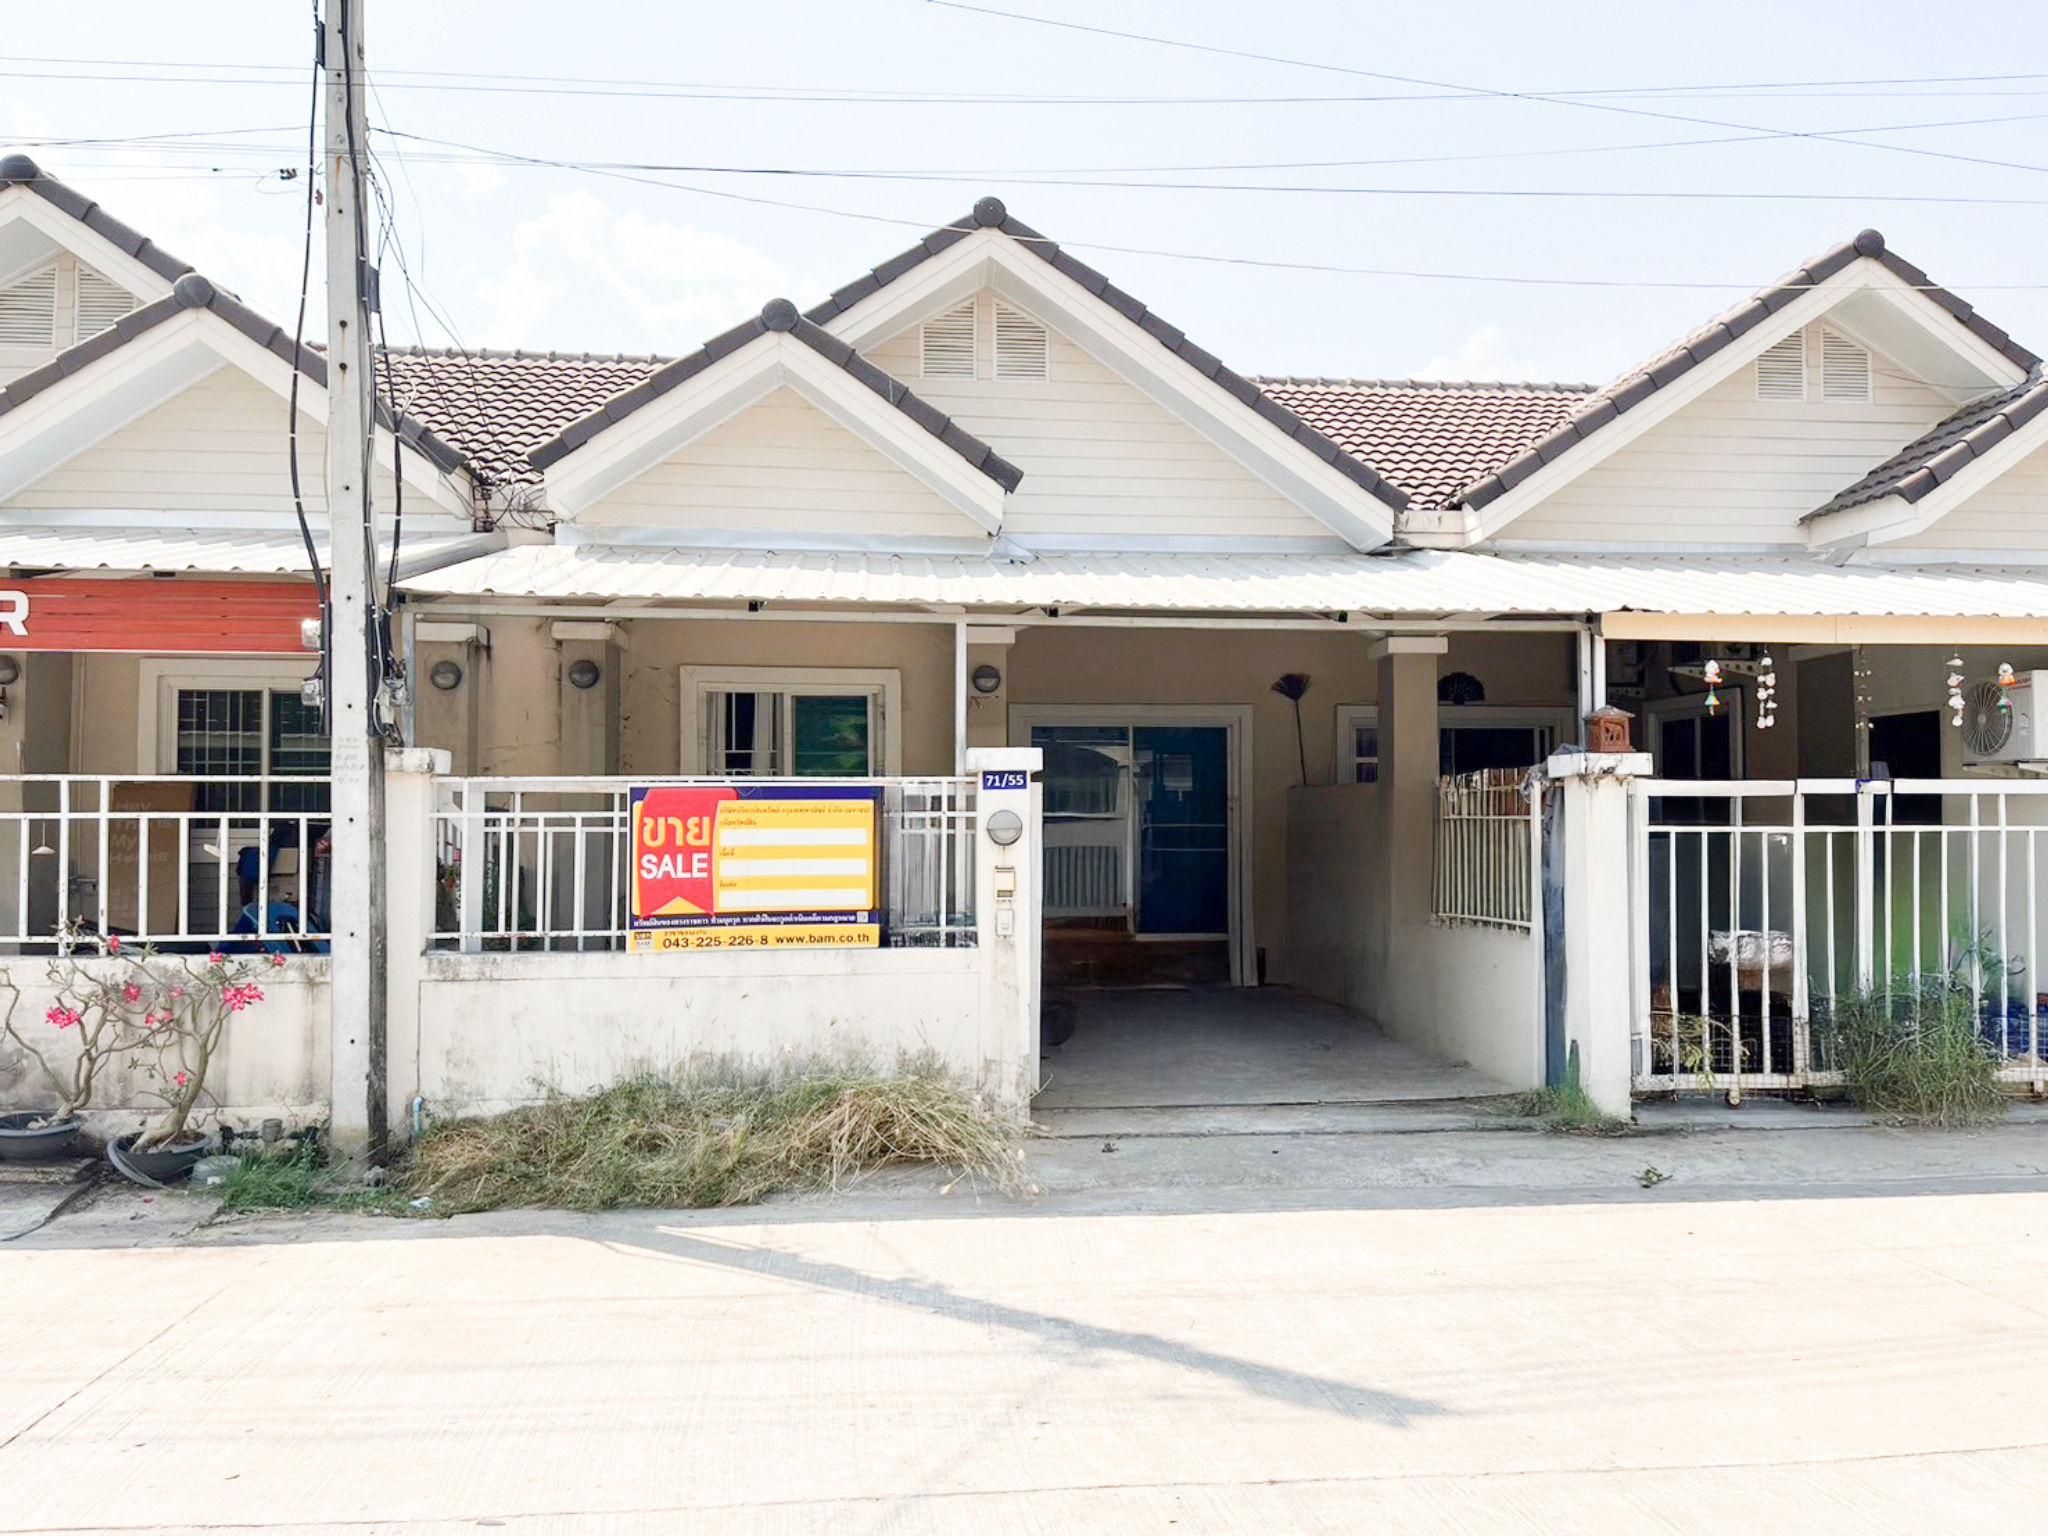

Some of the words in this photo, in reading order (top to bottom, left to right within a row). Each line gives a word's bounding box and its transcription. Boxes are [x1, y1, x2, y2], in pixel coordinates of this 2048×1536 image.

[985, 774, 1025, 788] 71/55
[642, 815, 710, 847] ขาย
[640, 853, 709, 879] SALE
[662, 935, 769, 949] 043-225-226-8
[775, 932, 870, 946] www.bam.co.th
